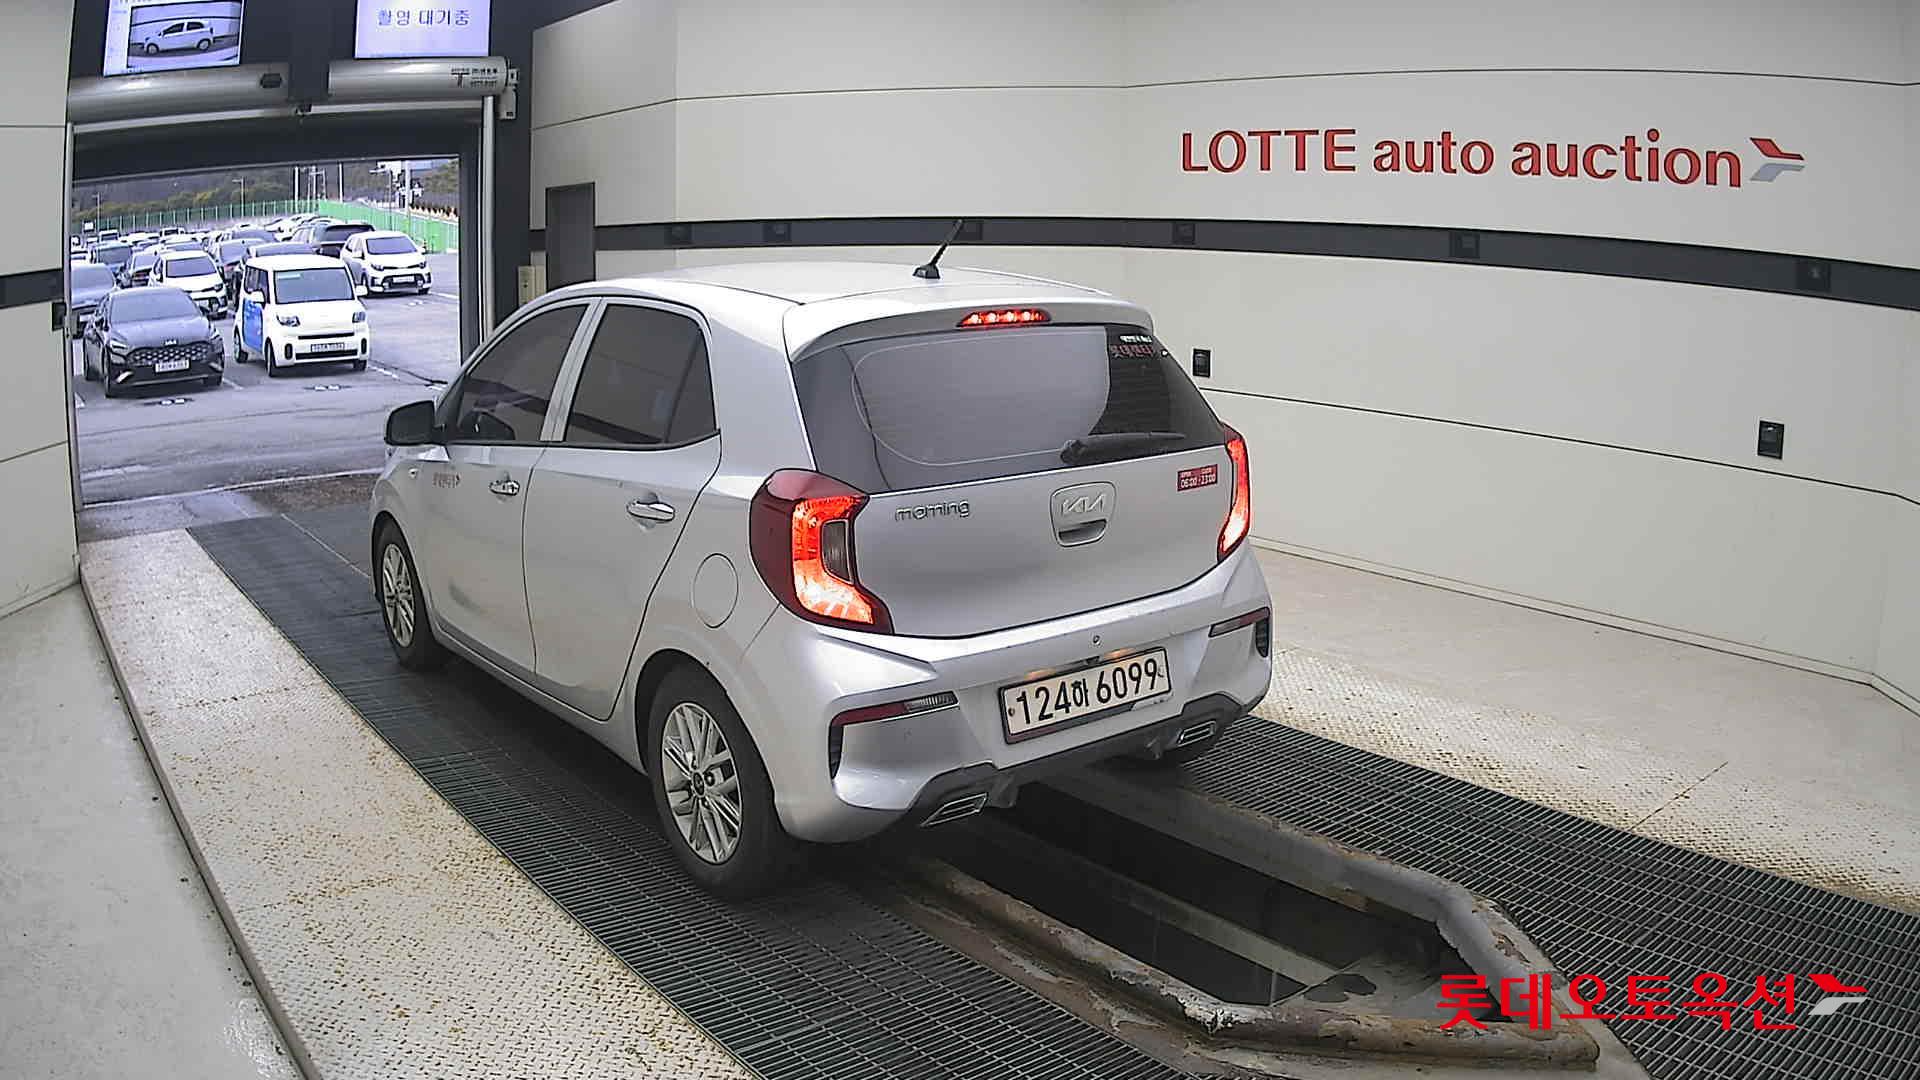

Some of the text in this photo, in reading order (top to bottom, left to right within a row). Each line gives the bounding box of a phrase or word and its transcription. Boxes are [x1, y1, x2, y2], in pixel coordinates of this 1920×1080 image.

[418, 9, 470, 26] 대기중
[1181, 127, 1742, 188] LOTTE auto auction
[894, 499, 970, 522] morning
[1061, 493, 1106, 516] KIA
[1016, 657, 1158, 725] 124하 6099
